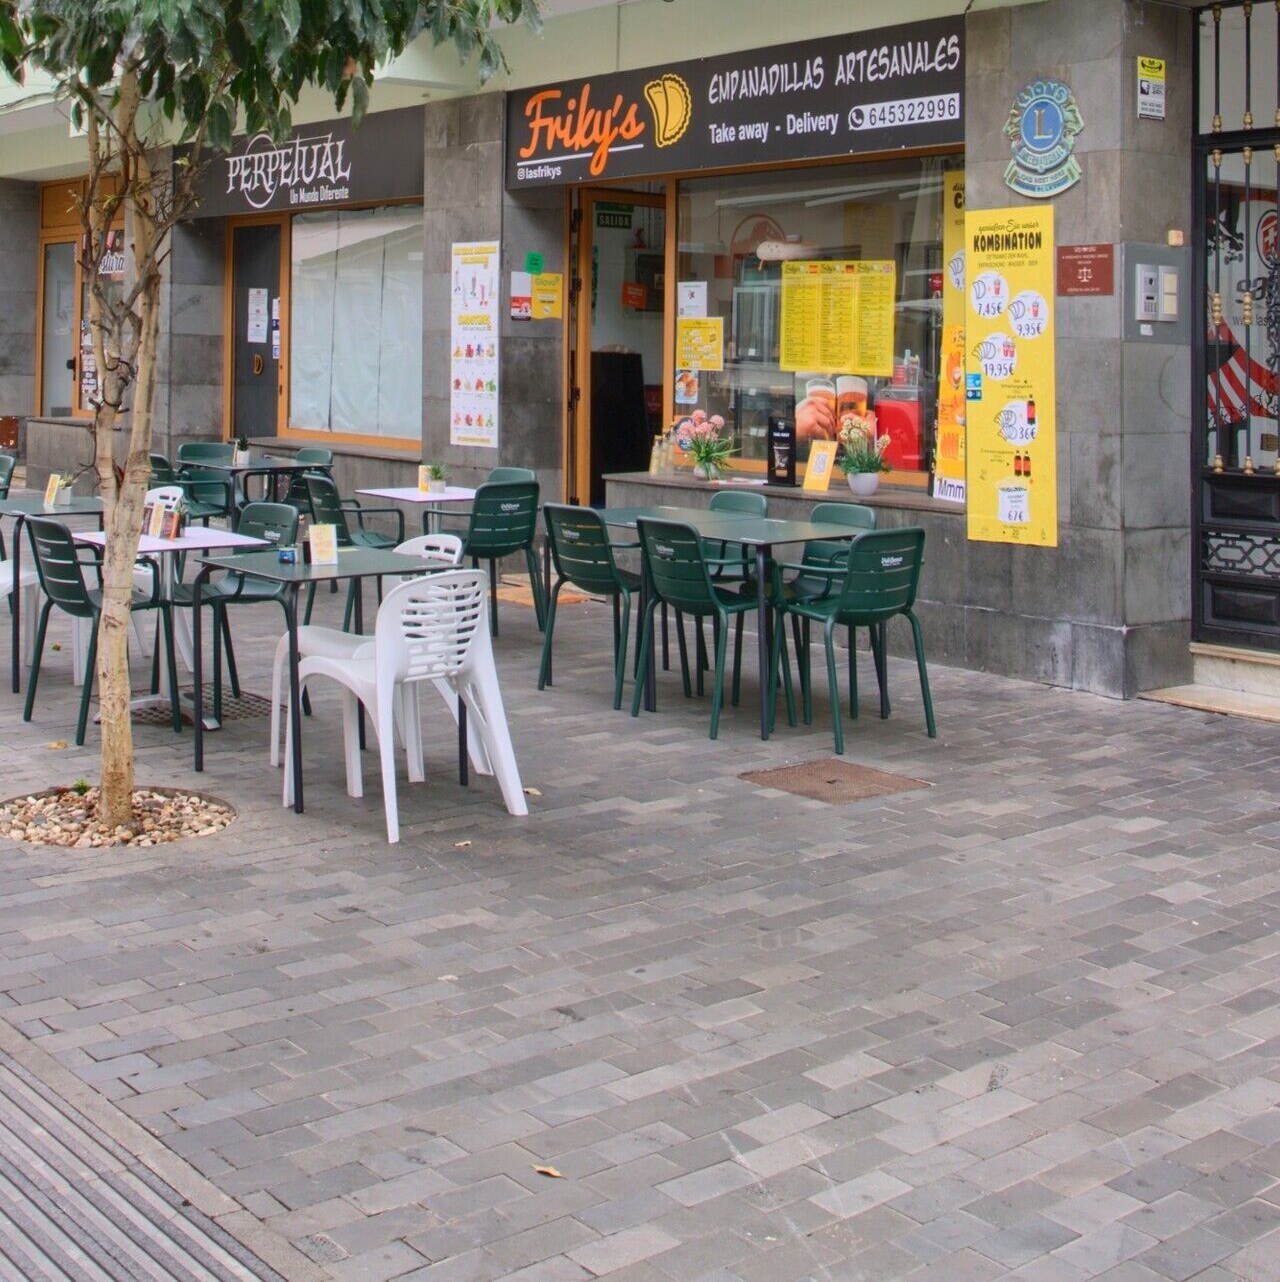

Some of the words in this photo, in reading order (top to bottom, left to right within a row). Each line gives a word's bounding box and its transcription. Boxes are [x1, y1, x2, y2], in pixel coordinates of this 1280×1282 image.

[707, 56, 824, 105] EMPANADILLAS
[834, 33, 961, 87] ARTESANALES
[1016, 80, 1069, 107] LIONS
[868, 97, 957, 125] 645322996
[1033, 109, 1054, 140] L
[519, 83, 646, 176] Friky's
[709, 122, 736, 145] Take
[738, 124, 770, 146] away
[786, 110, 840, 137] Delivery
[224, 132, 352, 195] PERPETUAL
[289, 188, 299, 205] Un
[320, 184, 349, 202] Diferente
[599, 214, 630, 226] SALIDA
[973, 231, 1042, 253] KOMBINATION
